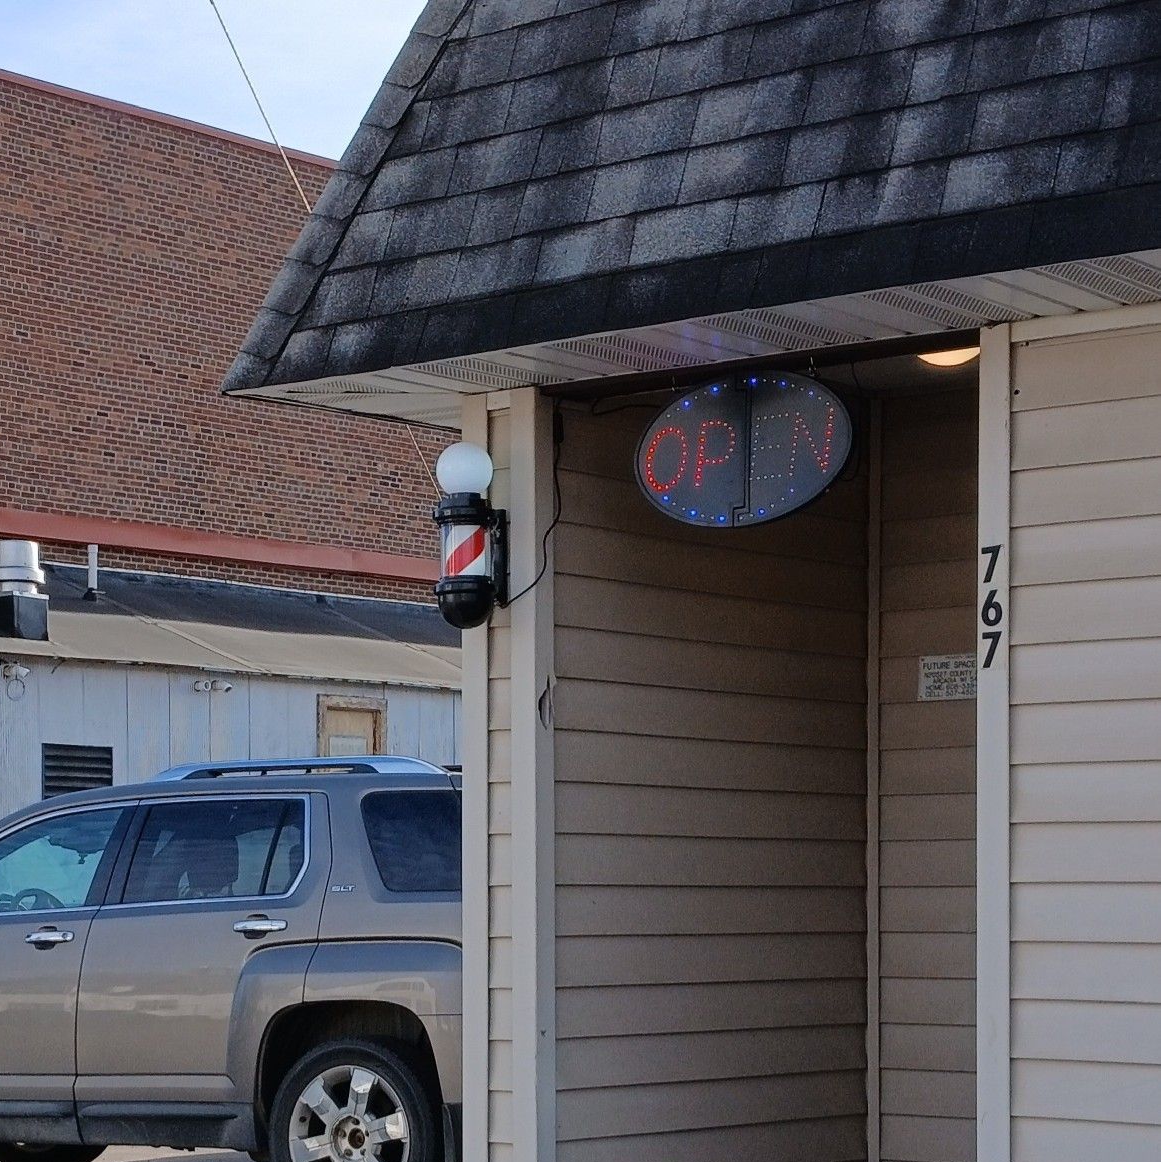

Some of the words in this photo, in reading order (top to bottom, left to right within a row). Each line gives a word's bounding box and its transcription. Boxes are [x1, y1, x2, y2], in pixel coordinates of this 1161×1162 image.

[645, 407, 834, 491] OPEN
[981, 544, 1003, 669] 767
[922, 661, 950, 670] FUTURE
[953, 660, 976, 669] SPACE
[949, 670, 973, 678] COUNTY
